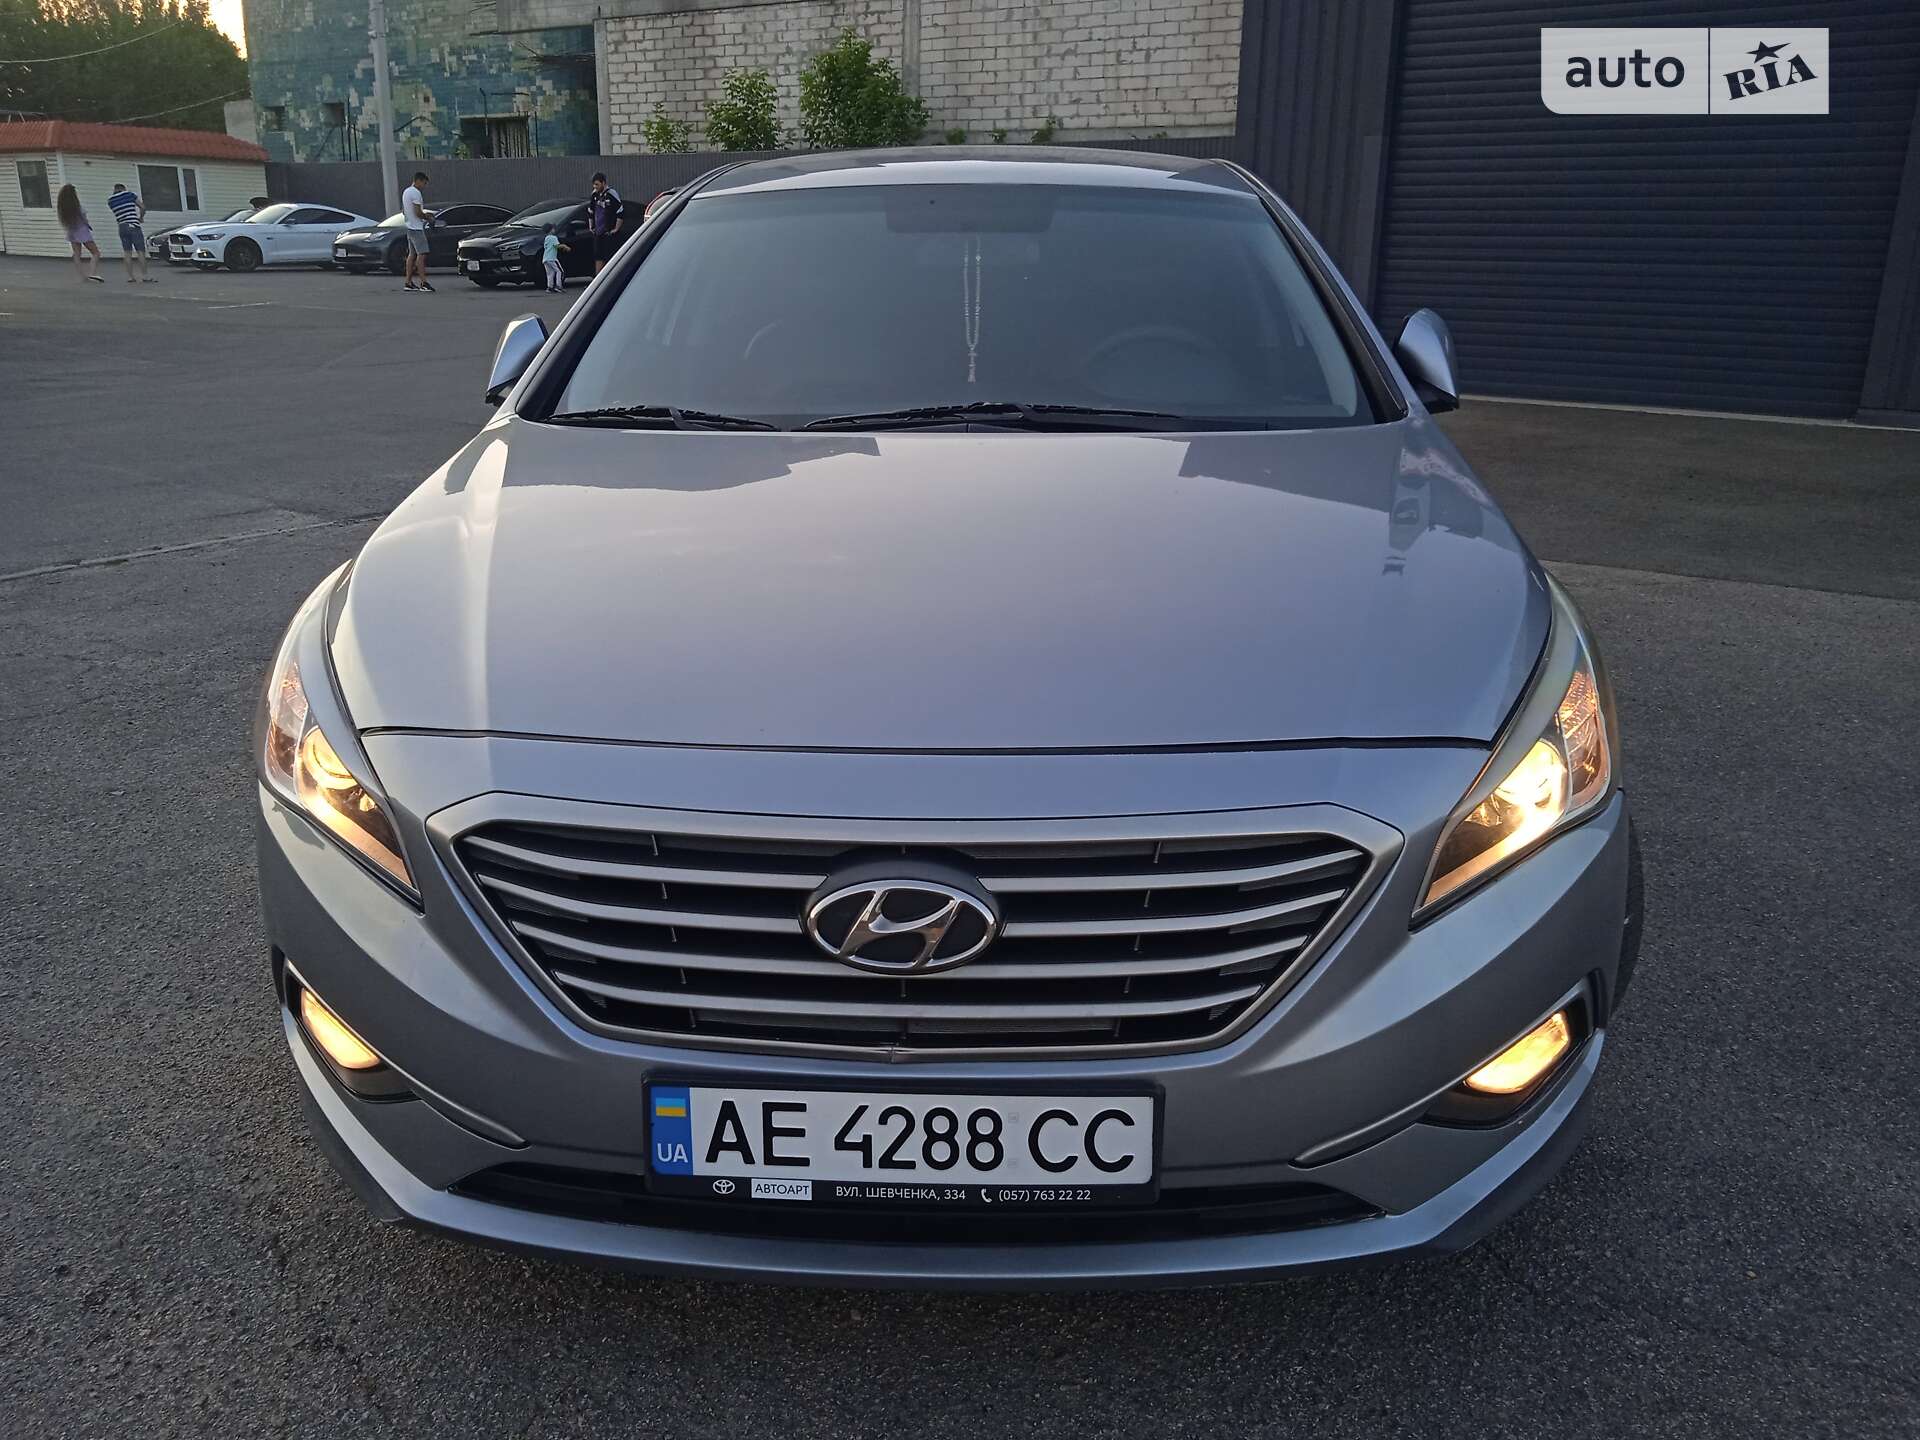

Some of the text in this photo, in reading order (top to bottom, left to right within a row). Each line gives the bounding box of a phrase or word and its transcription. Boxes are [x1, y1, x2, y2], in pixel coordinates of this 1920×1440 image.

[705, 1100, 1135, 1173] AE 4288 CC
[657, 1143, 689, 1163] UA
[754, 1183, 810, 1196] АВТОАРТ
[836, 1186, 966, 1200] ВУЛ. ШЕВЧЕНКА, 334
[999, 1189, 1091, 1202] (057) 763 22 22
